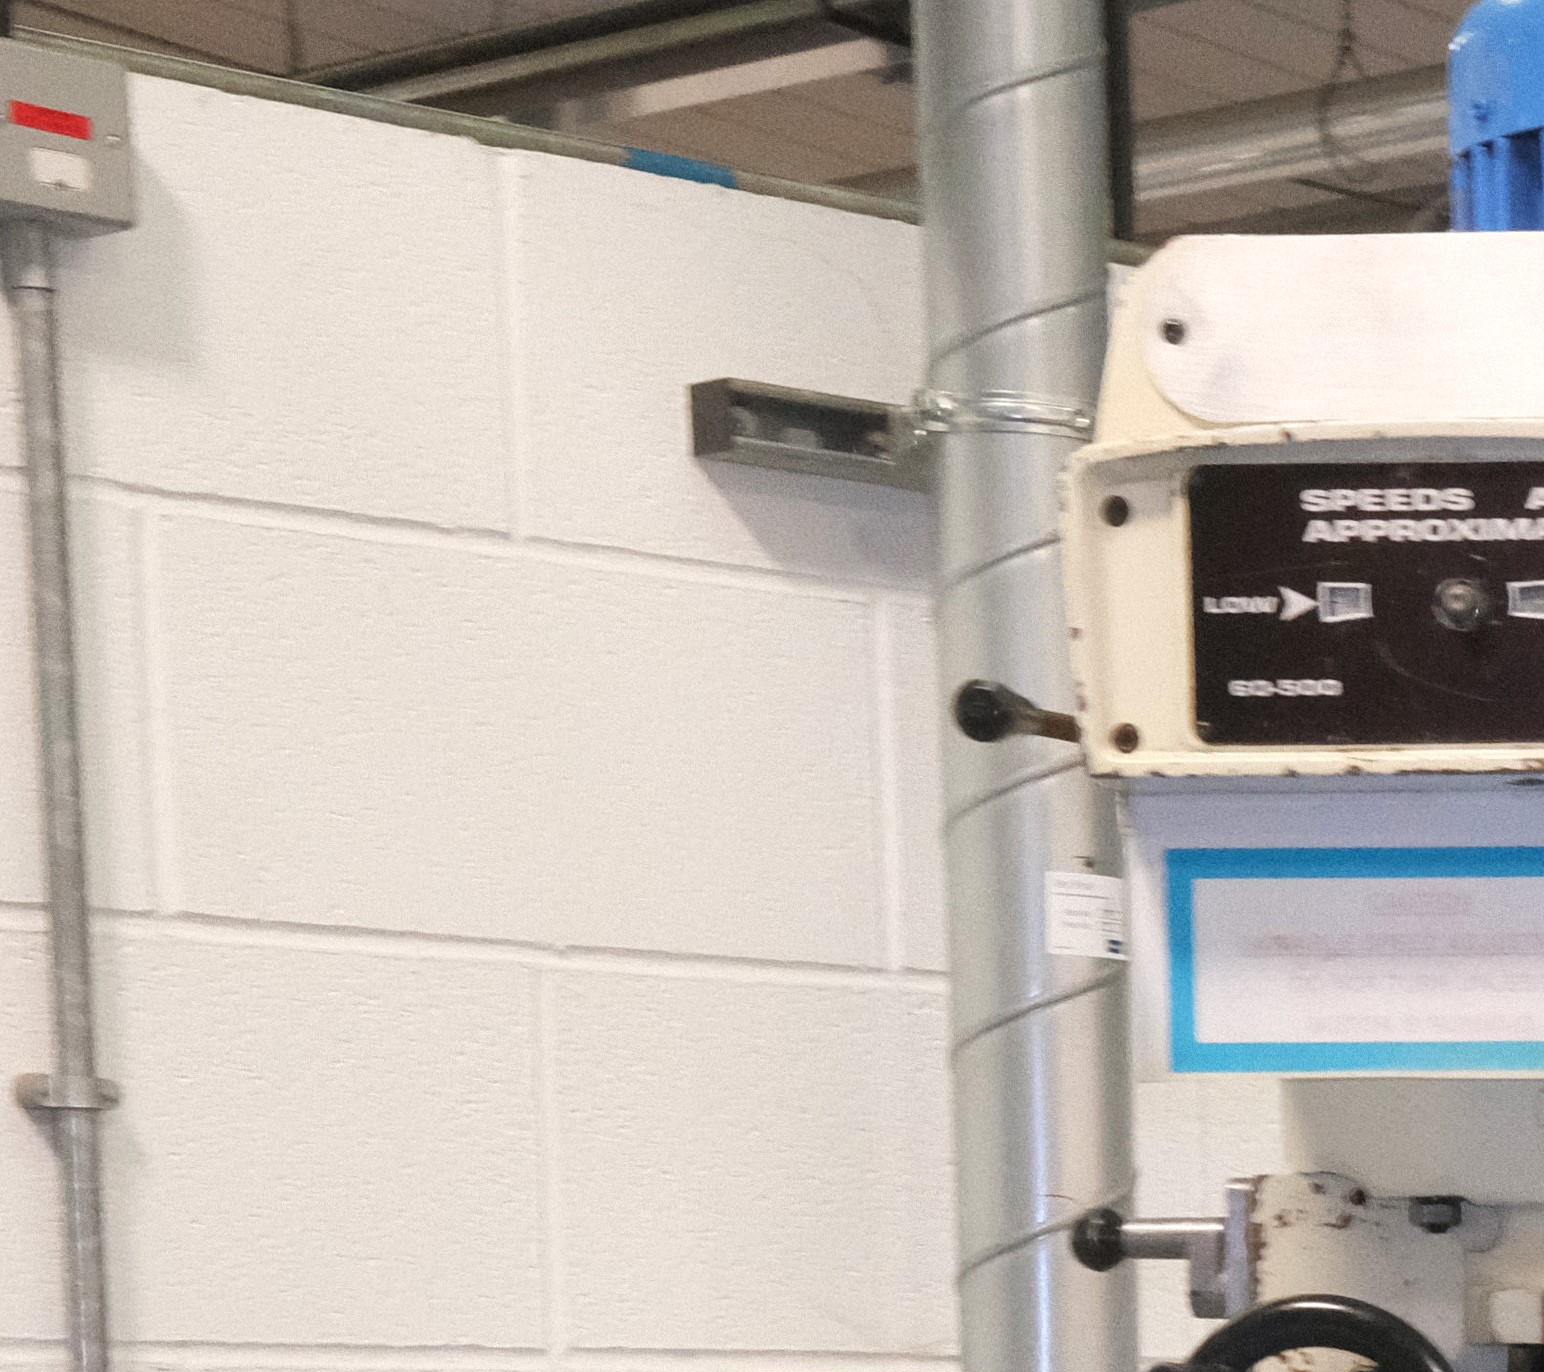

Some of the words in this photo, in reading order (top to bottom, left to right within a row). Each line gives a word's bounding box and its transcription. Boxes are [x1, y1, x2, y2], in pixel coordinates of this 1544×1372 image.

[1299, 488, 1474, 512] SPEEDS
[1203, 596, 1279, 614] LOW
[1227, 678, 1343, 697] 60-500
